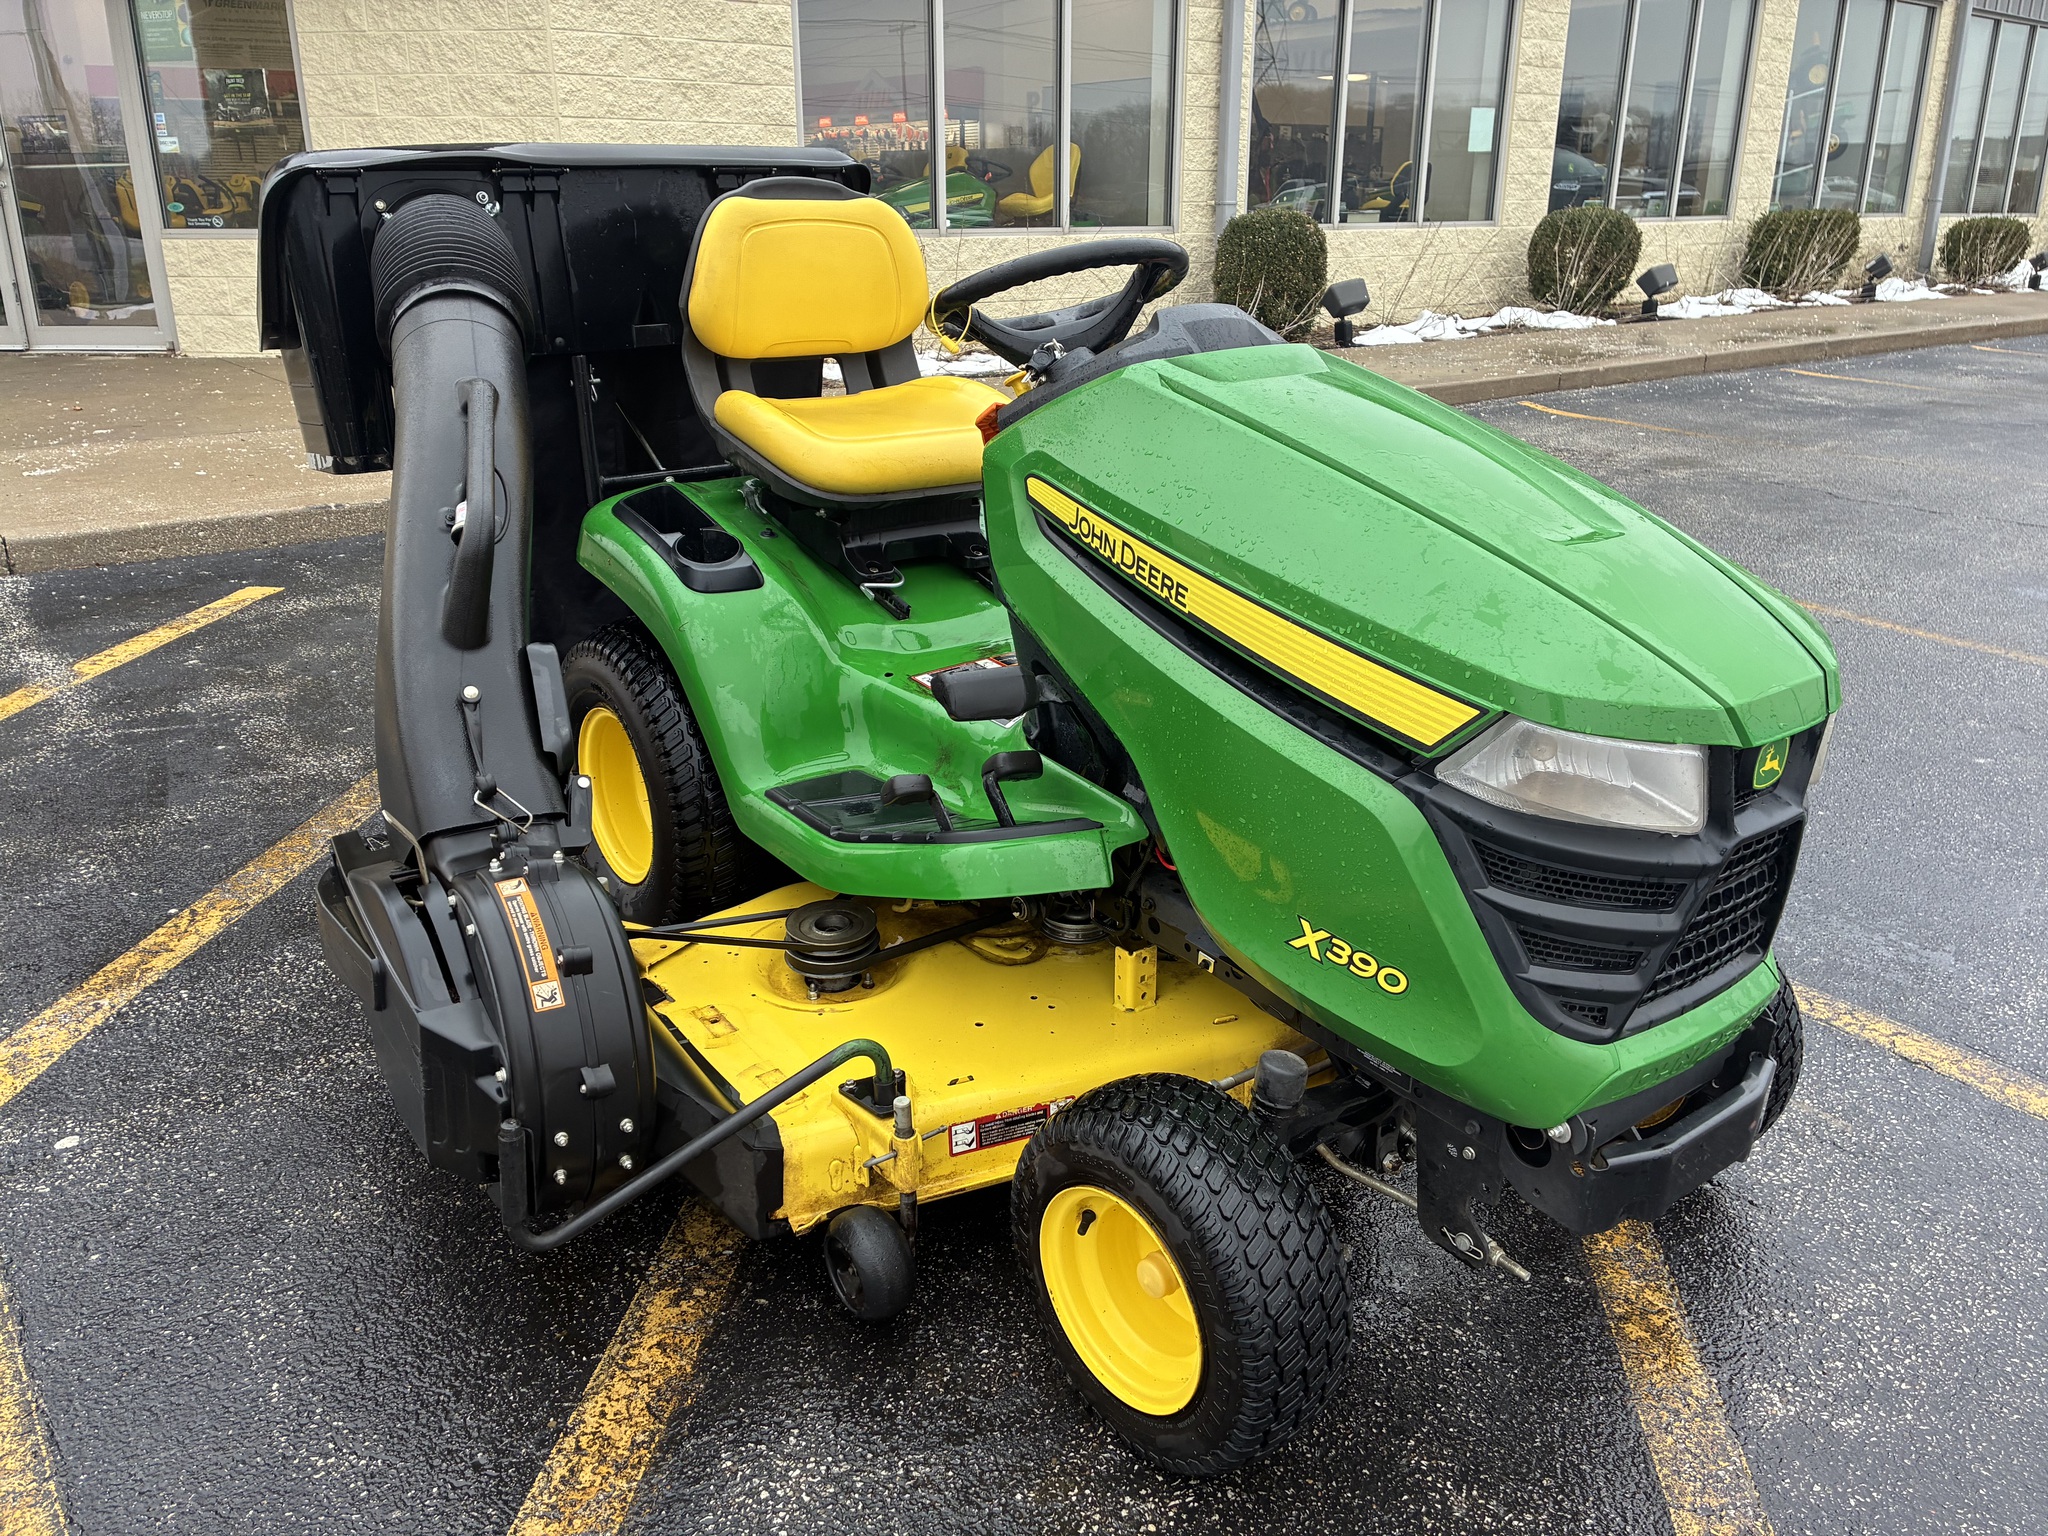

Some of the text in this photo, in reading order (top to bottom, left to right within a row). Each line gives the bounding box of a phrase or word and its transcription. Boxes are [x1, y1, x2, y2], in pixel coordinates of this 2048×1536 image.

[1068, 507, 1189, 610] JOHN DEERE
[532, 915, 549, 951] WARNING
[1284, 915, 1409, 994] X390
[536, 951, 547, 978] OBJECTS
